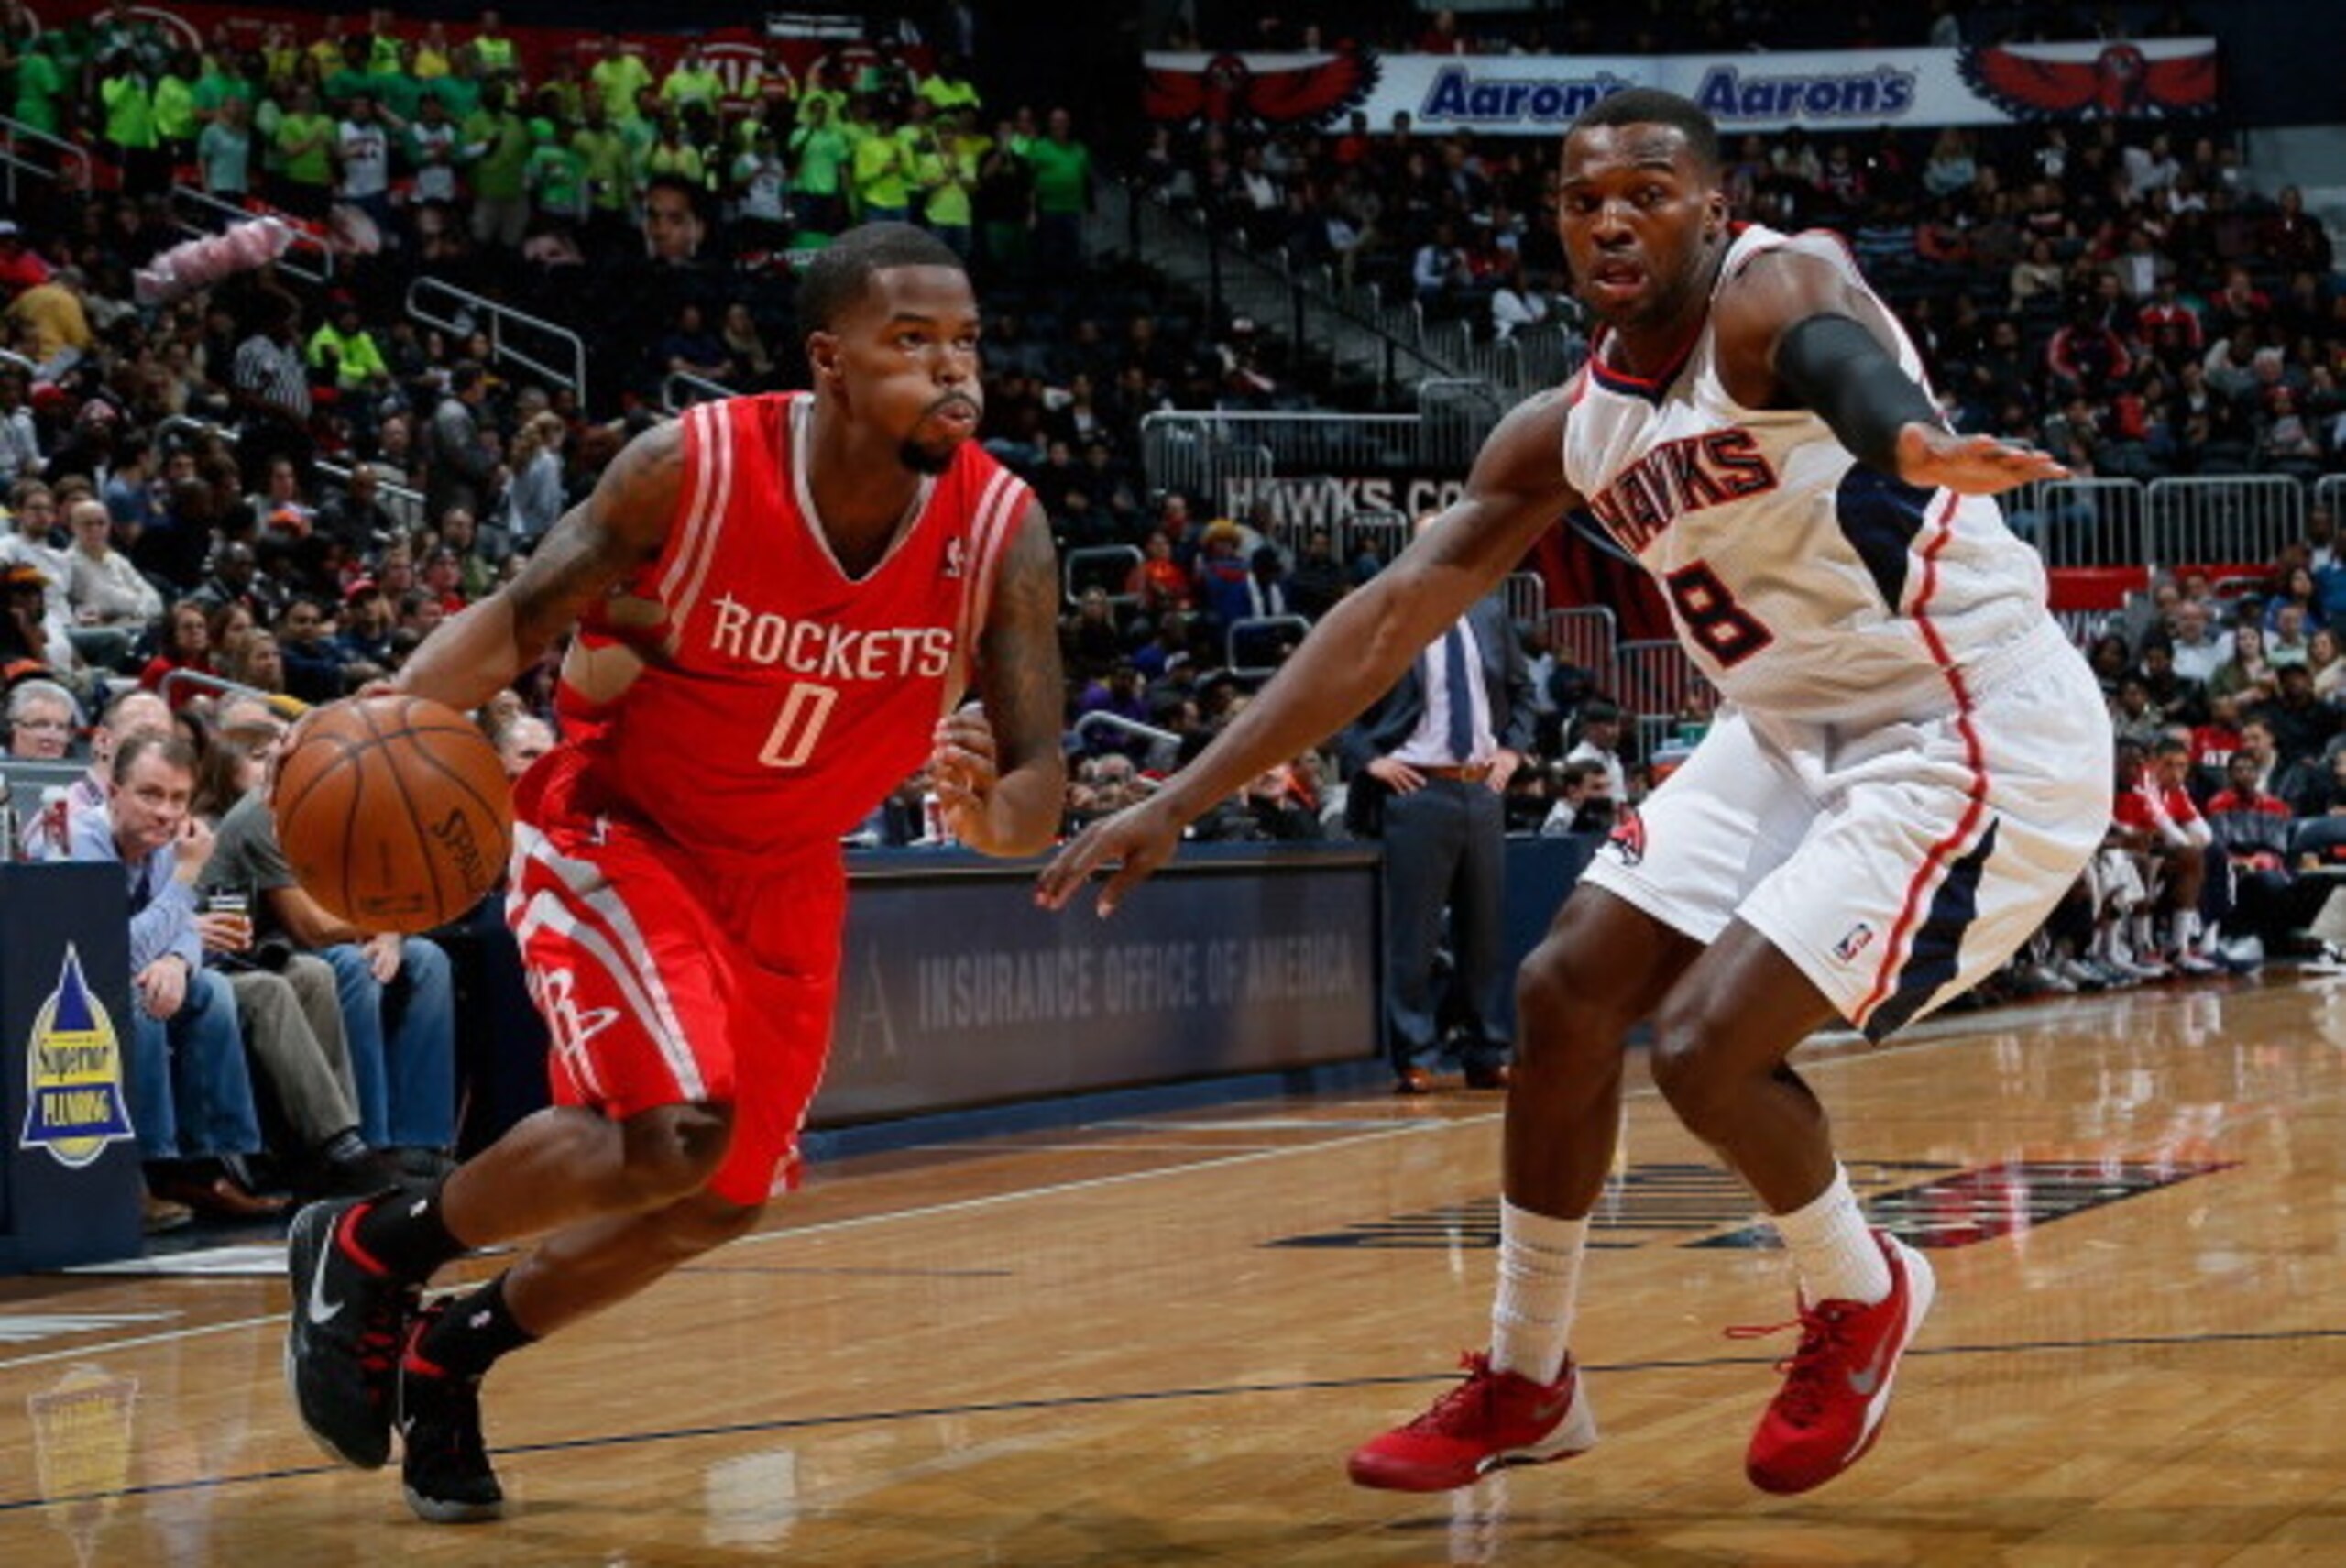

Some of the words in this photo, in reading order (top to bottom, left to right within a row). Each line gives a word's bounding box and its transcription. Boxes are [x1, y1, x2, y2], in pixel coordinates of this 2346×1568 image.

[1699, 70, 1914, 116] Aaron's
[711, 591, 953, 680] ROCKETS
[1664, 557, 1775, 670] 8
[758, 682, 839, 767] 0
[918, 947, 1092, 1032] INSURANCE
[1103, 941, 1198, 1014] OFFICE
[1206, 936, 1240, 1005] OF
[1246, 930, 1353, 1004] AMERICA
